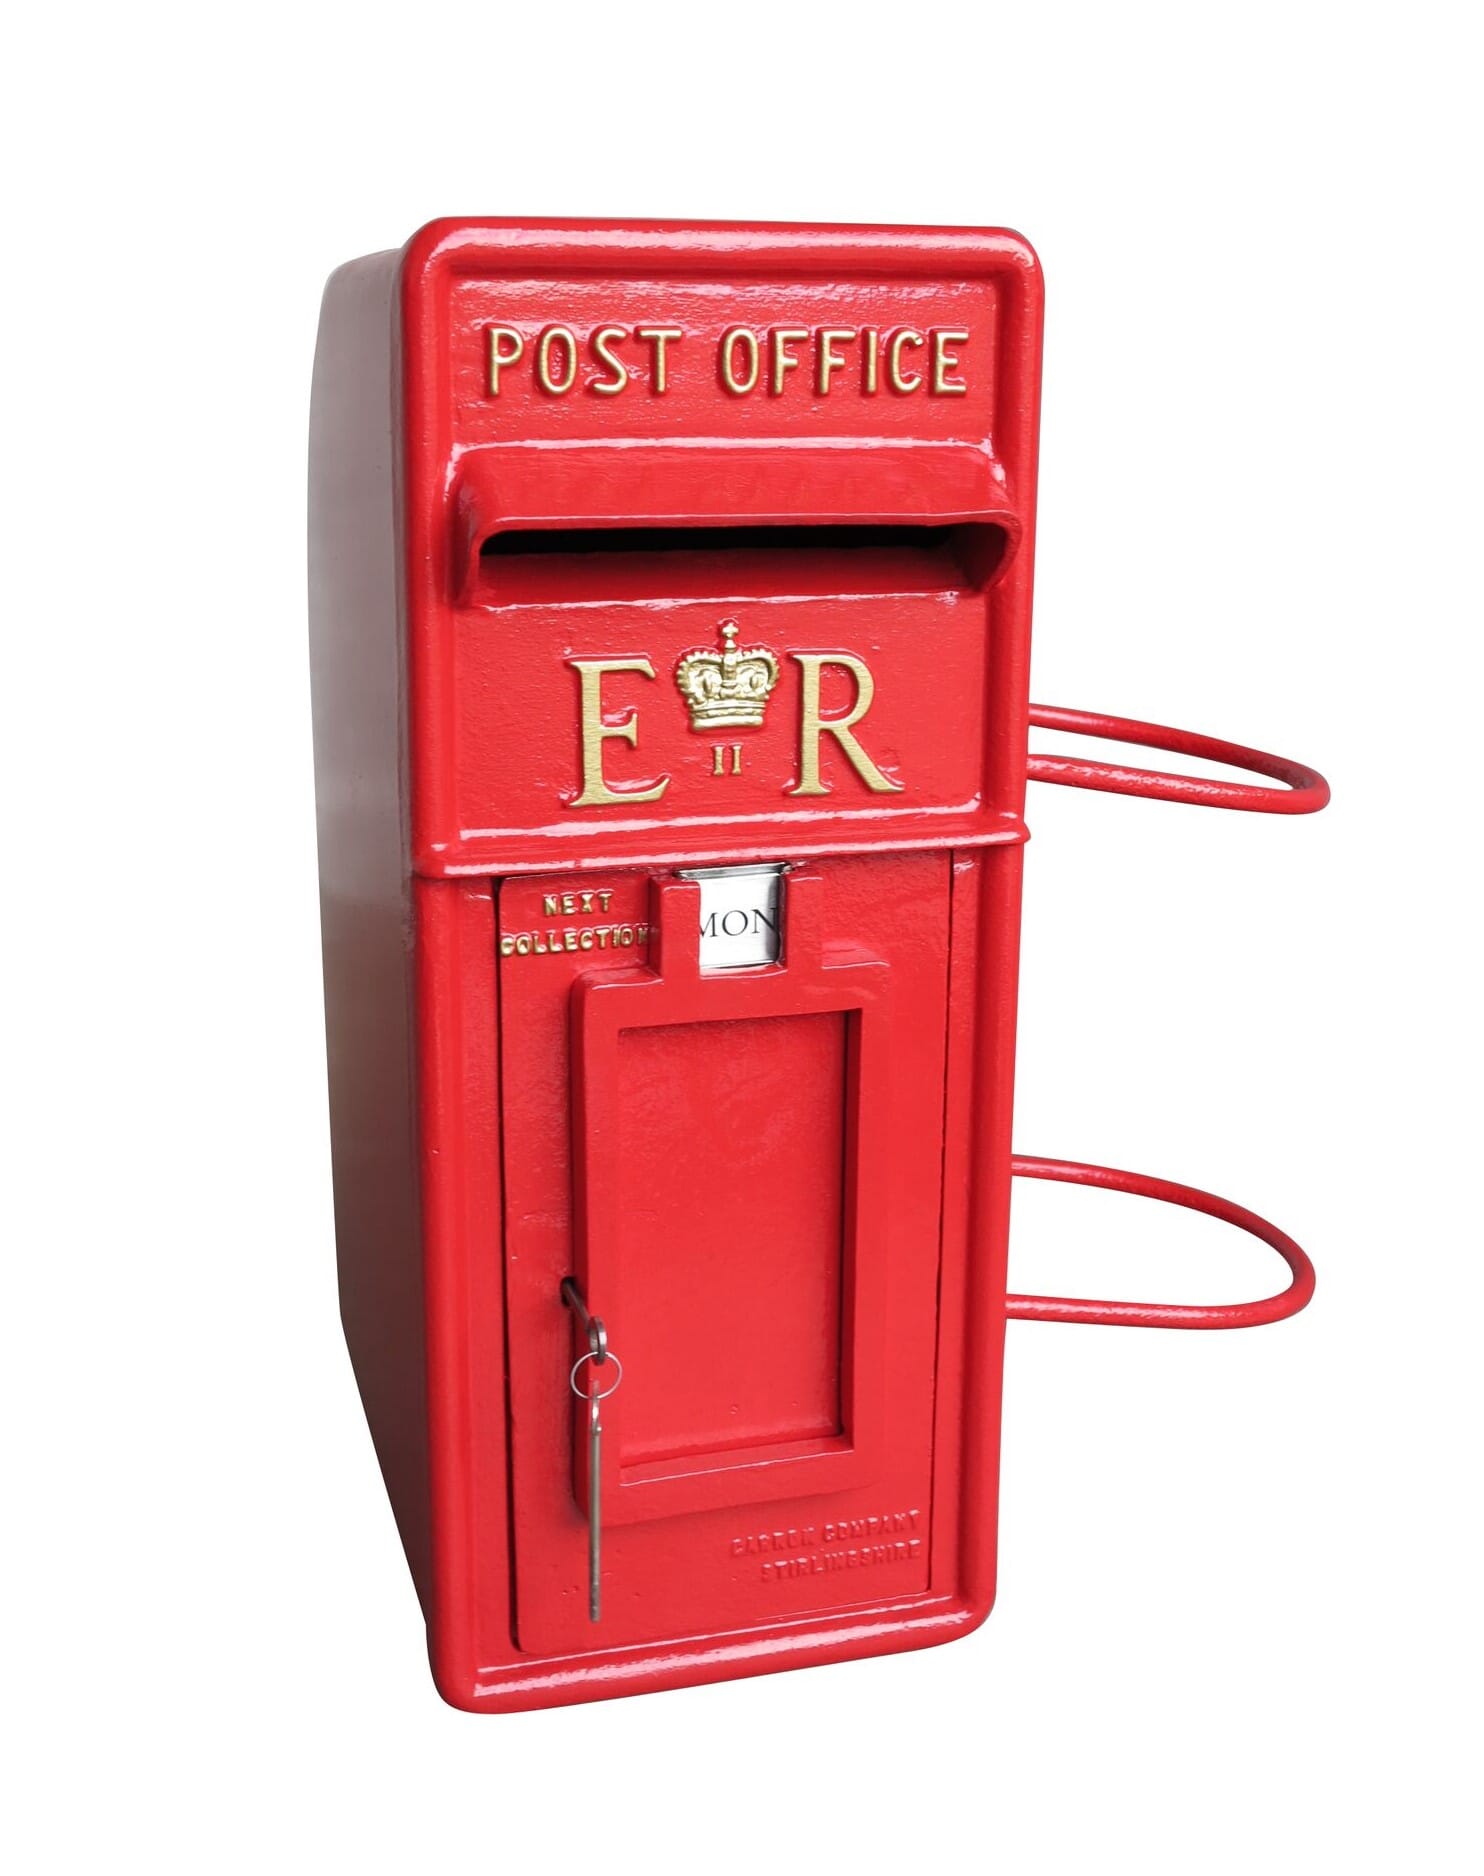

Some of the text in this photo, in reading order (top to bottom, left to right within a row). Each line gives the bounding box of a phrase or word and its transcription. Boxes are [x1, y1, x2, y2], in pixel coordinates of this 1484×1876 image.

[490, 326, 969, 395] POST OFFICE
[567, 653, 905, 808] E R
[713, 744, 742, 776] II
[543, 890, 612, 916] NEXT
[500, 925, 650, 956] COLLECTION
[822, 1509, 920, 1544] COMPANY
[760, 1539, 921, 1582] STIRLINGSHIRE
